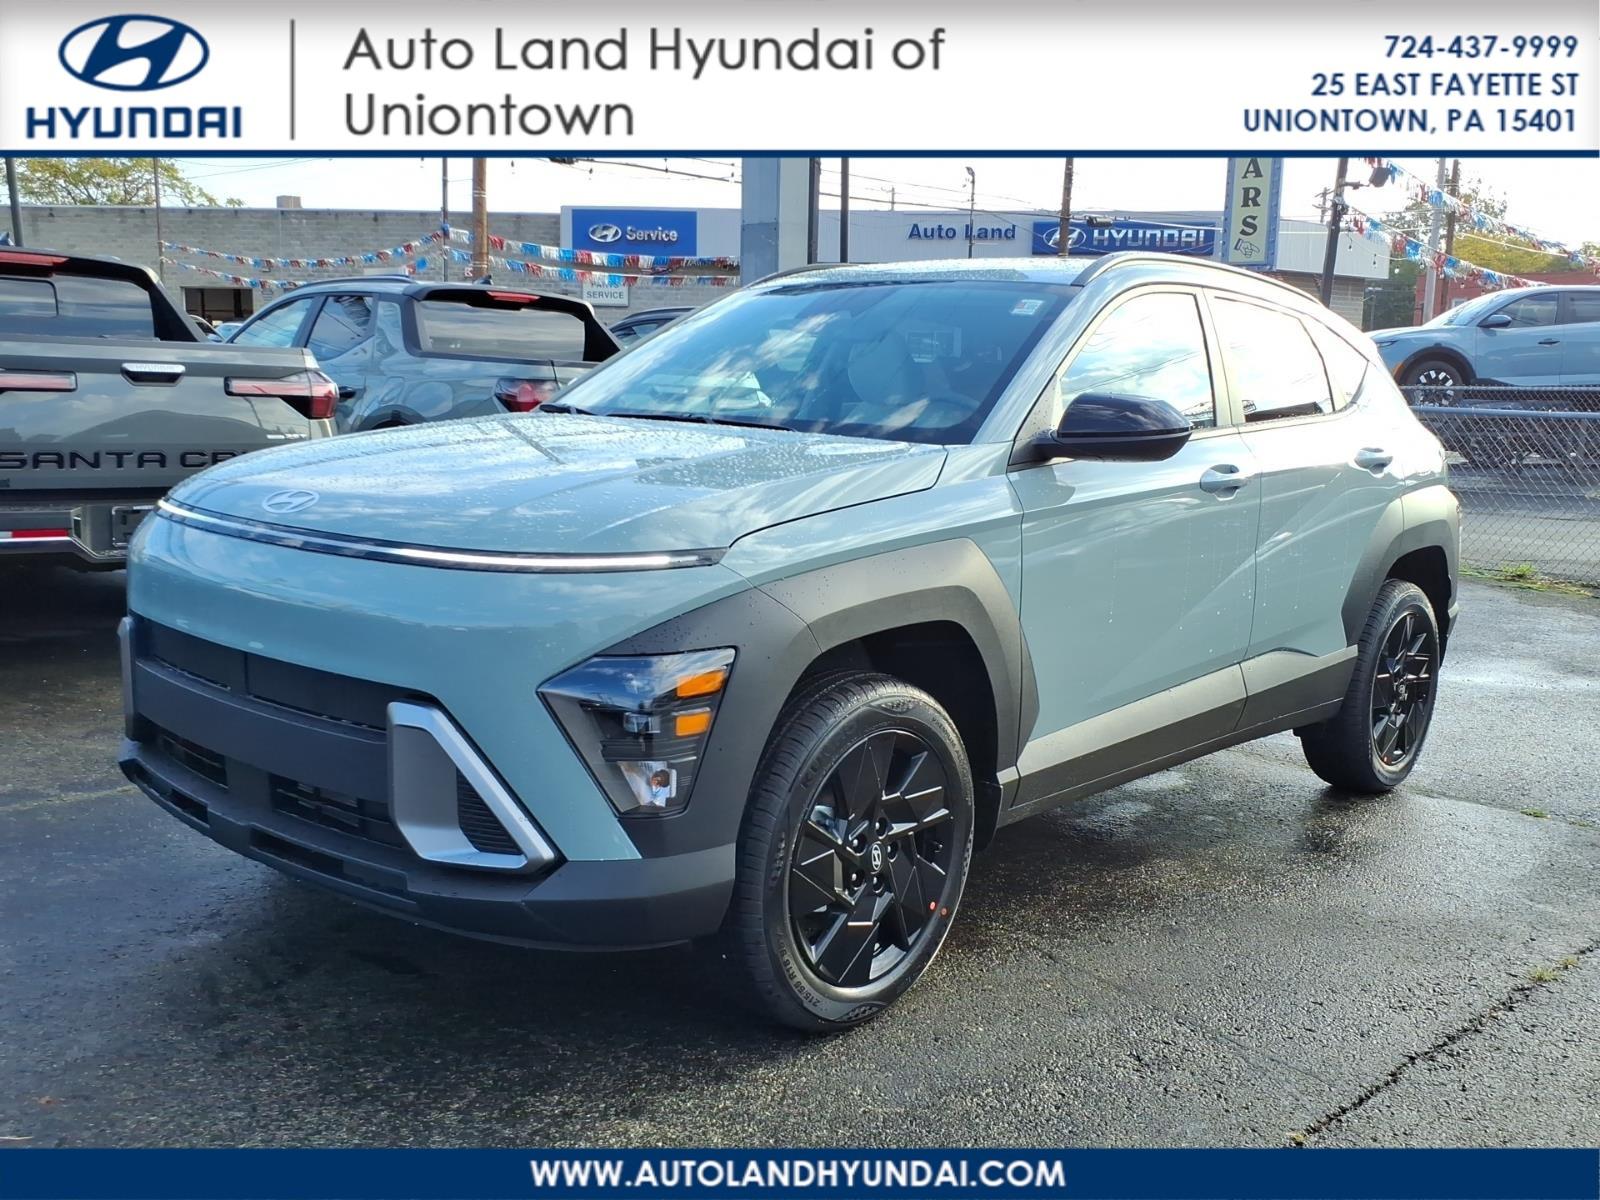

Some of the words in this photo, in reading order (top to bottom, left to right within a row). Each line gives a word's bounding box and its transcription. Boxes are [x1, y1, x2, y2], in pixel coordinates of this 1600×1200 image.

[626, 226, 679, 242] Service
[908, 223, 957, 239] Auto
[965, 223, 1016, 239] Land
[1093, 229, 1205, 247] HYUNDAI
[586, 291, 624, 299] SERVICE
[0, 452, 168, 470] SANTA
